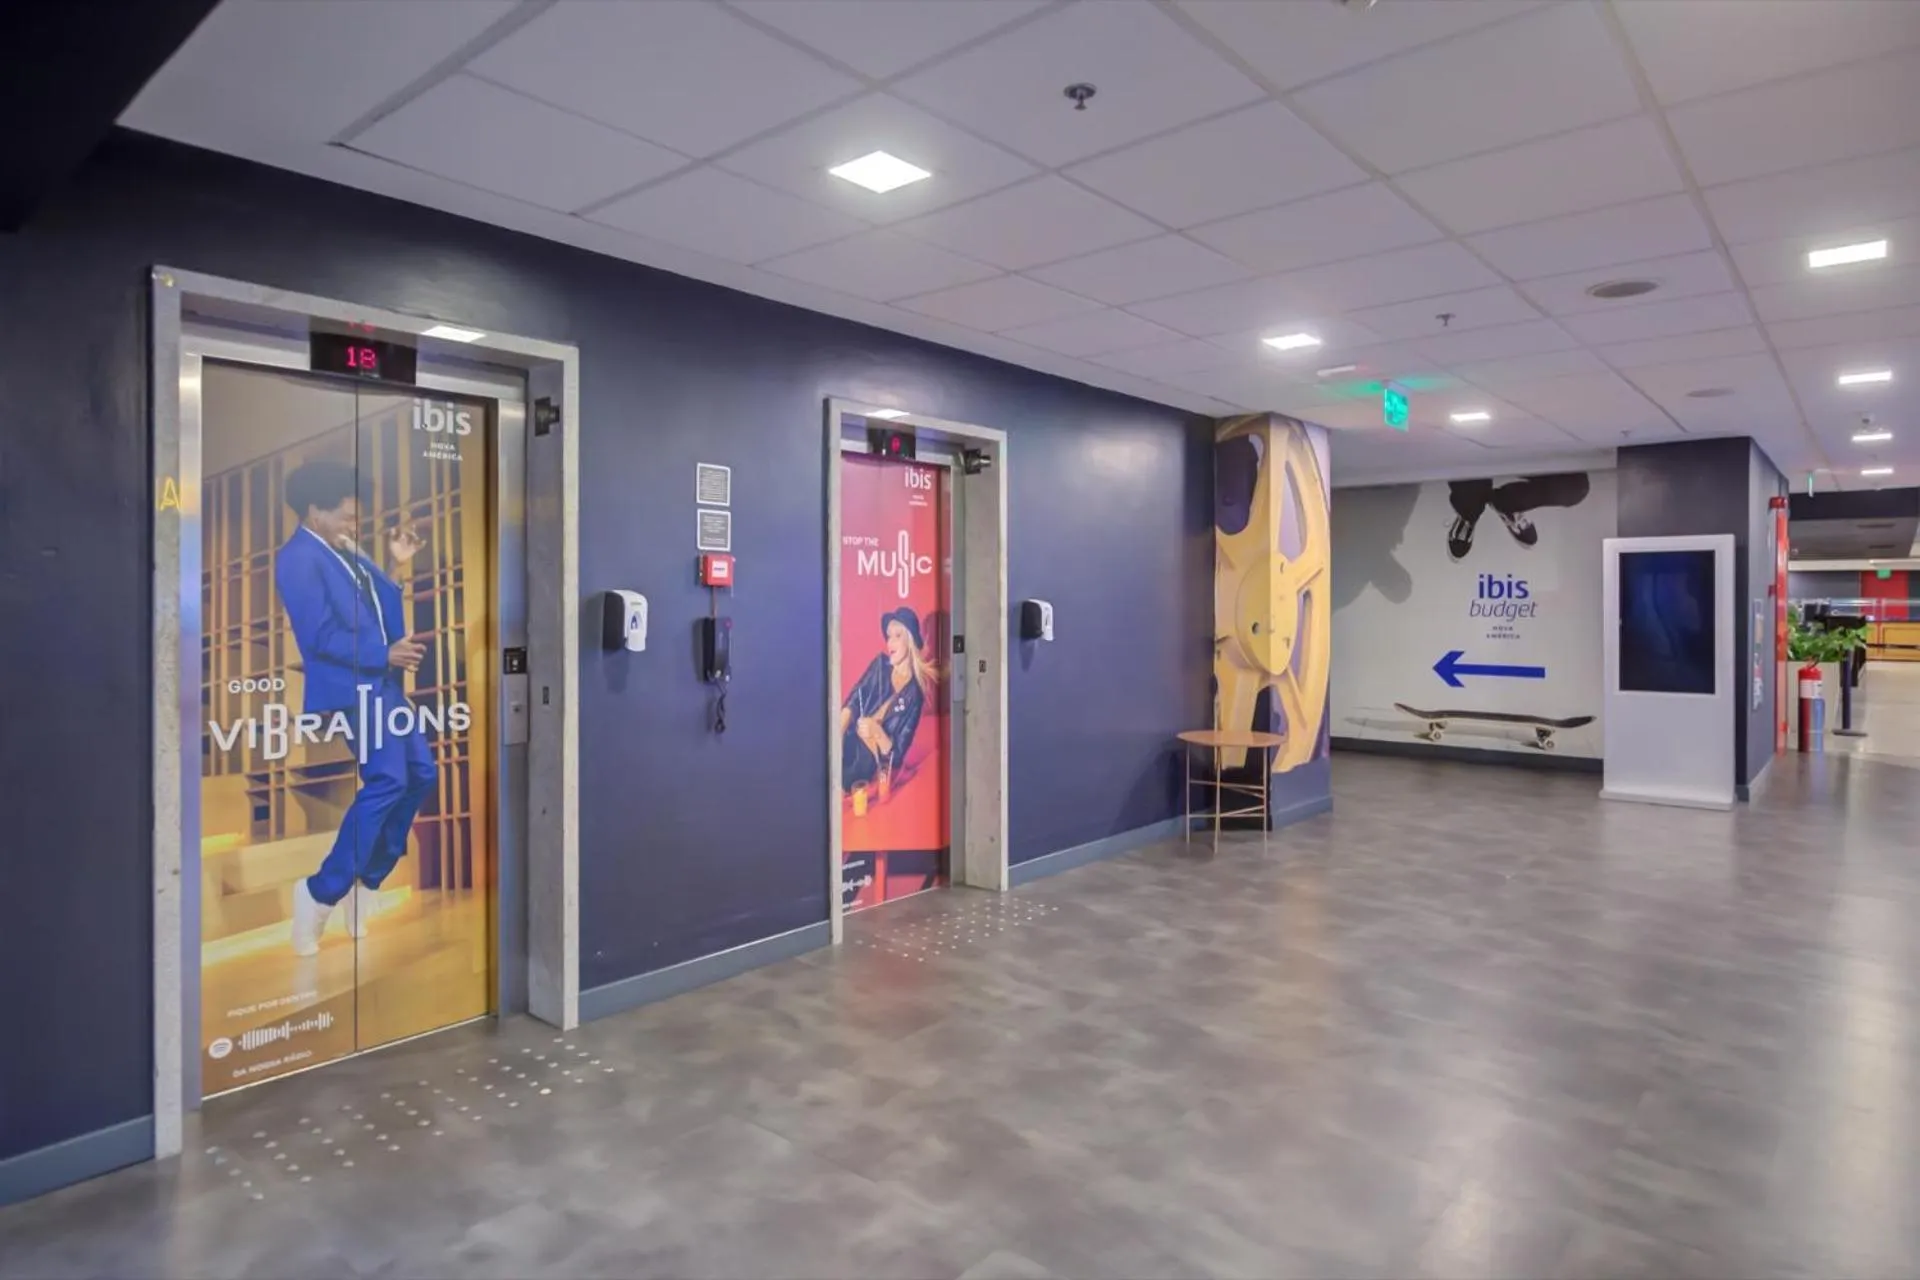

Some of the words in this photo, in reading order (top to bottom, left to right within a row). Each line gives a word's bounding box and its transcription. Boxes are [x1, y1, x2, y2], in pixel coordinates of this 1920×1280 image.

[346, 346, 377, 369] 18
[413, 398, 472, 435] ibis
[904, 466, 932, 490] ibis
[842, 535, 864, 546] STOP
[864, 536, 880, 548] THE
[857, 530, 933, 598] MUSIC
[1479, 573, 1529, 599] ibis
[1470, 600, 1538, 622] budget
[228, 679, 285, 694] GOOD
[208, 684, 471, 764] VIBRATIONS
